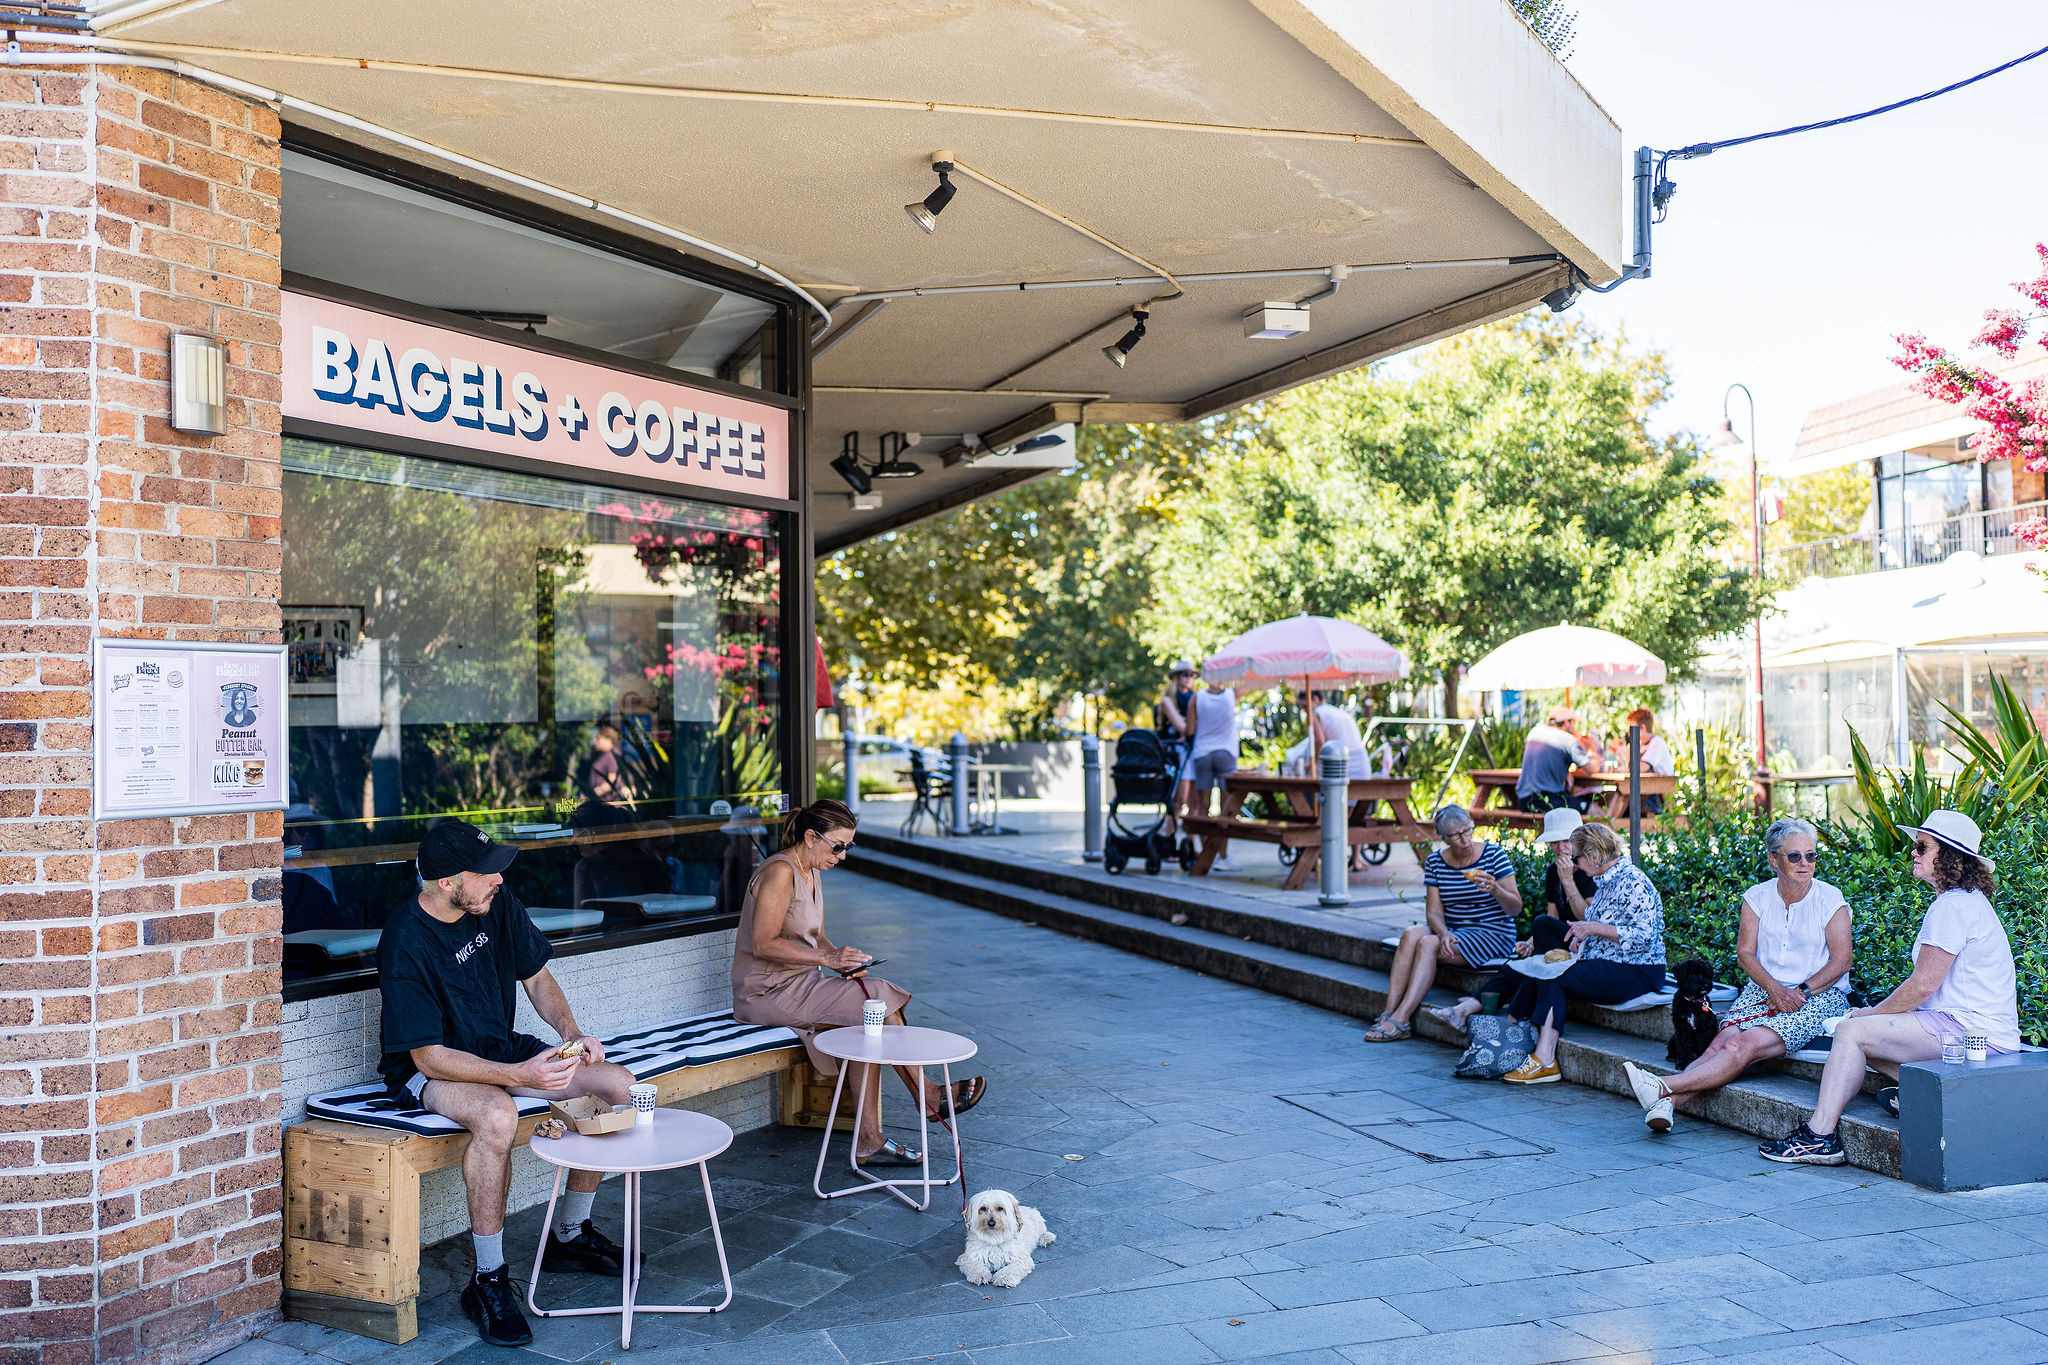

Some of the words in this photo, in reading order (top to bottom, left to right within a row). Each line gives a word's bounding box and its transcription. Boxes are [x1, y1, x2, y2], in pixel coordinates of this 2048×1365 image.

[312, 325, 548, 442] BAGELS
[558, 394, 588, 441] +
[597, 391, 766, 479] COFFEE
[136, 665, 160, 677] Bagel
[142, 661, 157, 669] Best
[221, 728, 257, 738] Peanut
[215, 739, 246, 751] BUTTER
[247, 739, 263, 751] BAR
[213, 764, 241, 783] KING
[475, 932, 489, 948] SB
